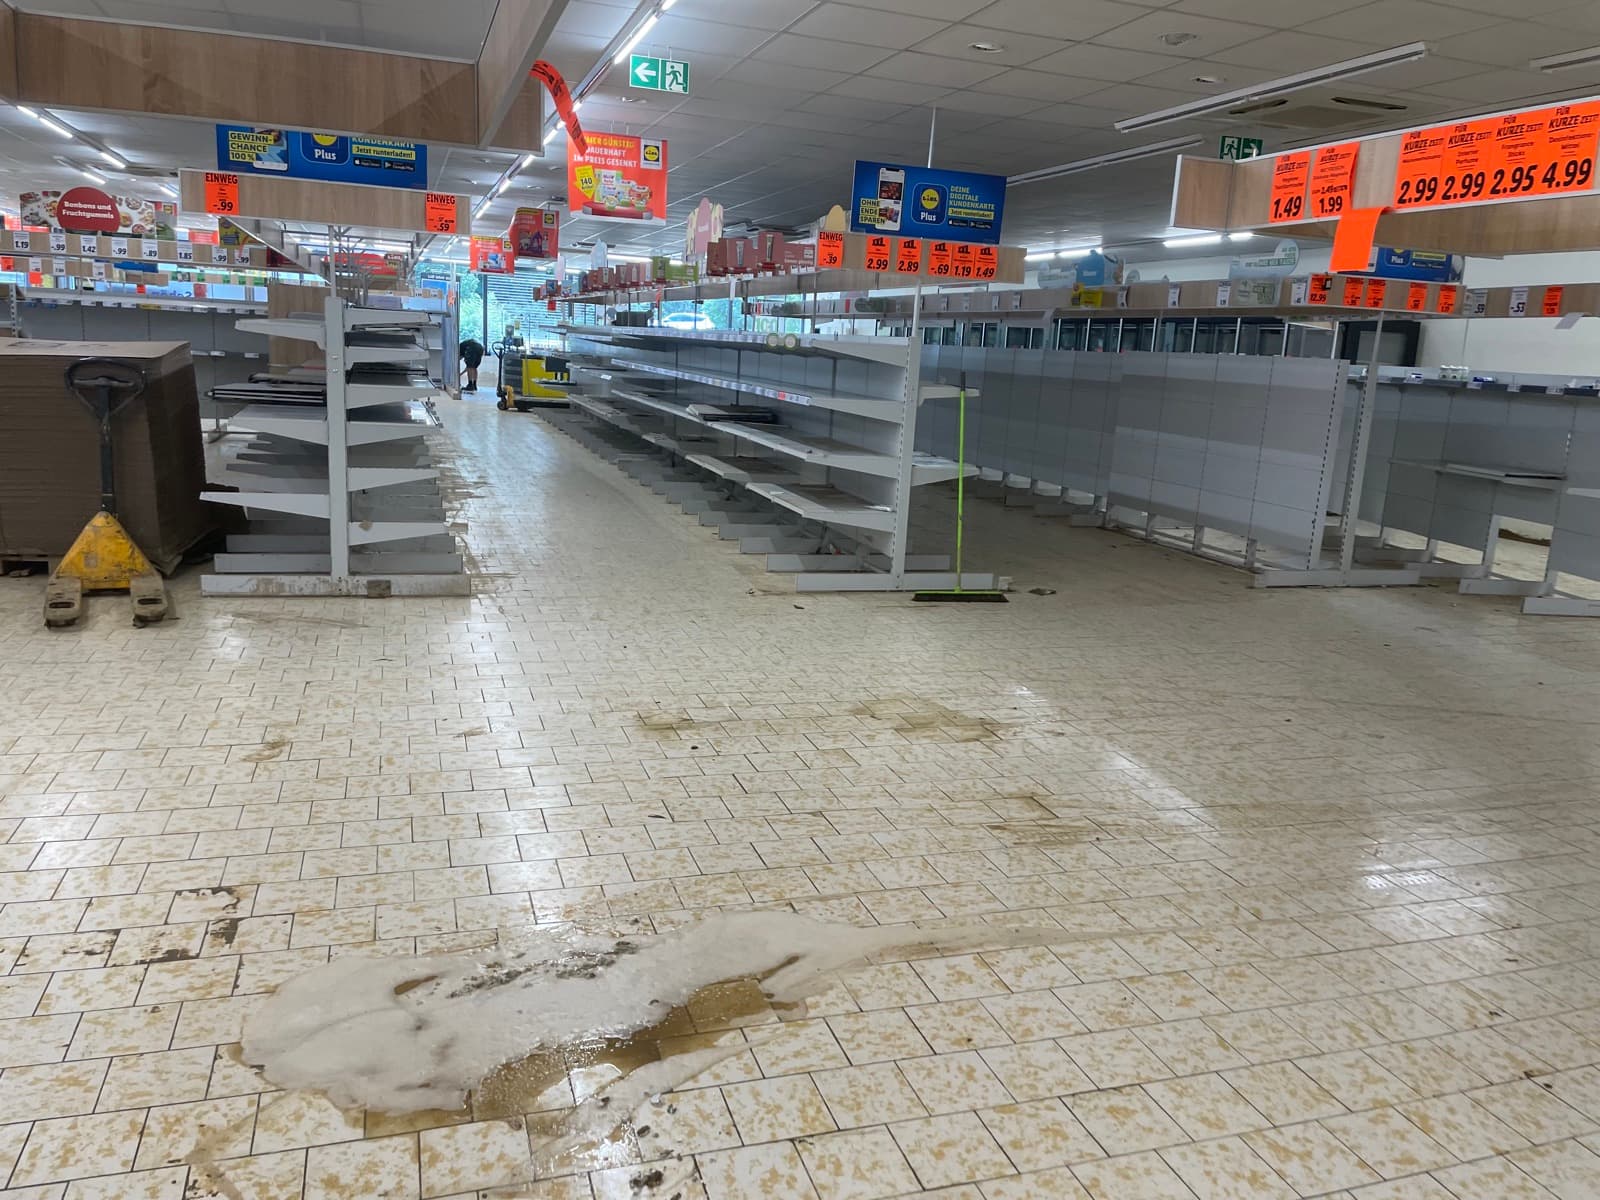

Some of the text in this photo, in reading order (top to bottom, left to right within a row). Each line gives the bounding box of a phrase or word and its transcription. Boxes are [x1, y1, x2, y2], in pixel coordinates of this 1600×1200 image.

[1556, 106, 1570, 115] FÜR
[1503, 115, 1517, 124] FÜR
[1549, 115, 1580, 128] KURZE
[1455, 124, 1467, 132] FÜR
[1497, 124, 1525, 137] KURZE
[230, 132, 272, 143] GEWINN-
[1410, 131, 1421, 139] FÜR
[1448, 132, 1476, 145] KURZE
[230, 143, 267, 152] CHANCE
[1403, 139, 1429, 151] KURZE
[314, 149, 336, 160] Plus
[355, 146, 412, 158] Jetzt runterladen!
[585, 156, 605, 164] PREIS
[606, 158, 637, 167] GESENKT
[205, 172, 238, 184] EINWEG
[1541, 158, 1592, 188] 4.99
[1490, 164, 1538, 194] 2.95
[950, 185, 970, 193] DEINE
[1397, 177, 1438, 204] 2.99
[1441, 172, 1485, 200] 2.99
[426, 193, 456, 204] EINWEG
[950, 193, 979, 201] DIGITALE
[64, 201, 96, 209] Bonbons
[861, 199, 880, 207] OHNE
[949, 200, 995, 210] KUNDENKARTE
[1274, 196, 1302, 219] 1.49
[1319, 196, 1343, 213] 1.99
[62, 209, 114, 219] Fruchtgummis
[860, 207, 878, 215] ENDE
[920, 211, 936, 221] Plus
[860, 215, 885, 224] SPAREN
[820, 231, 843, 241] EINWEG
[15, 241, 29, 249] 1.19
[82, 245, 96, 253] 1.42
[867, 258, 888, 270] 2.99
[898, 260, 919, 272] 2.89
[931, 263, 949, 274] -.69
[955, 265, 971, 277] 1.19
[976, 267, 994, 278] 1.49
